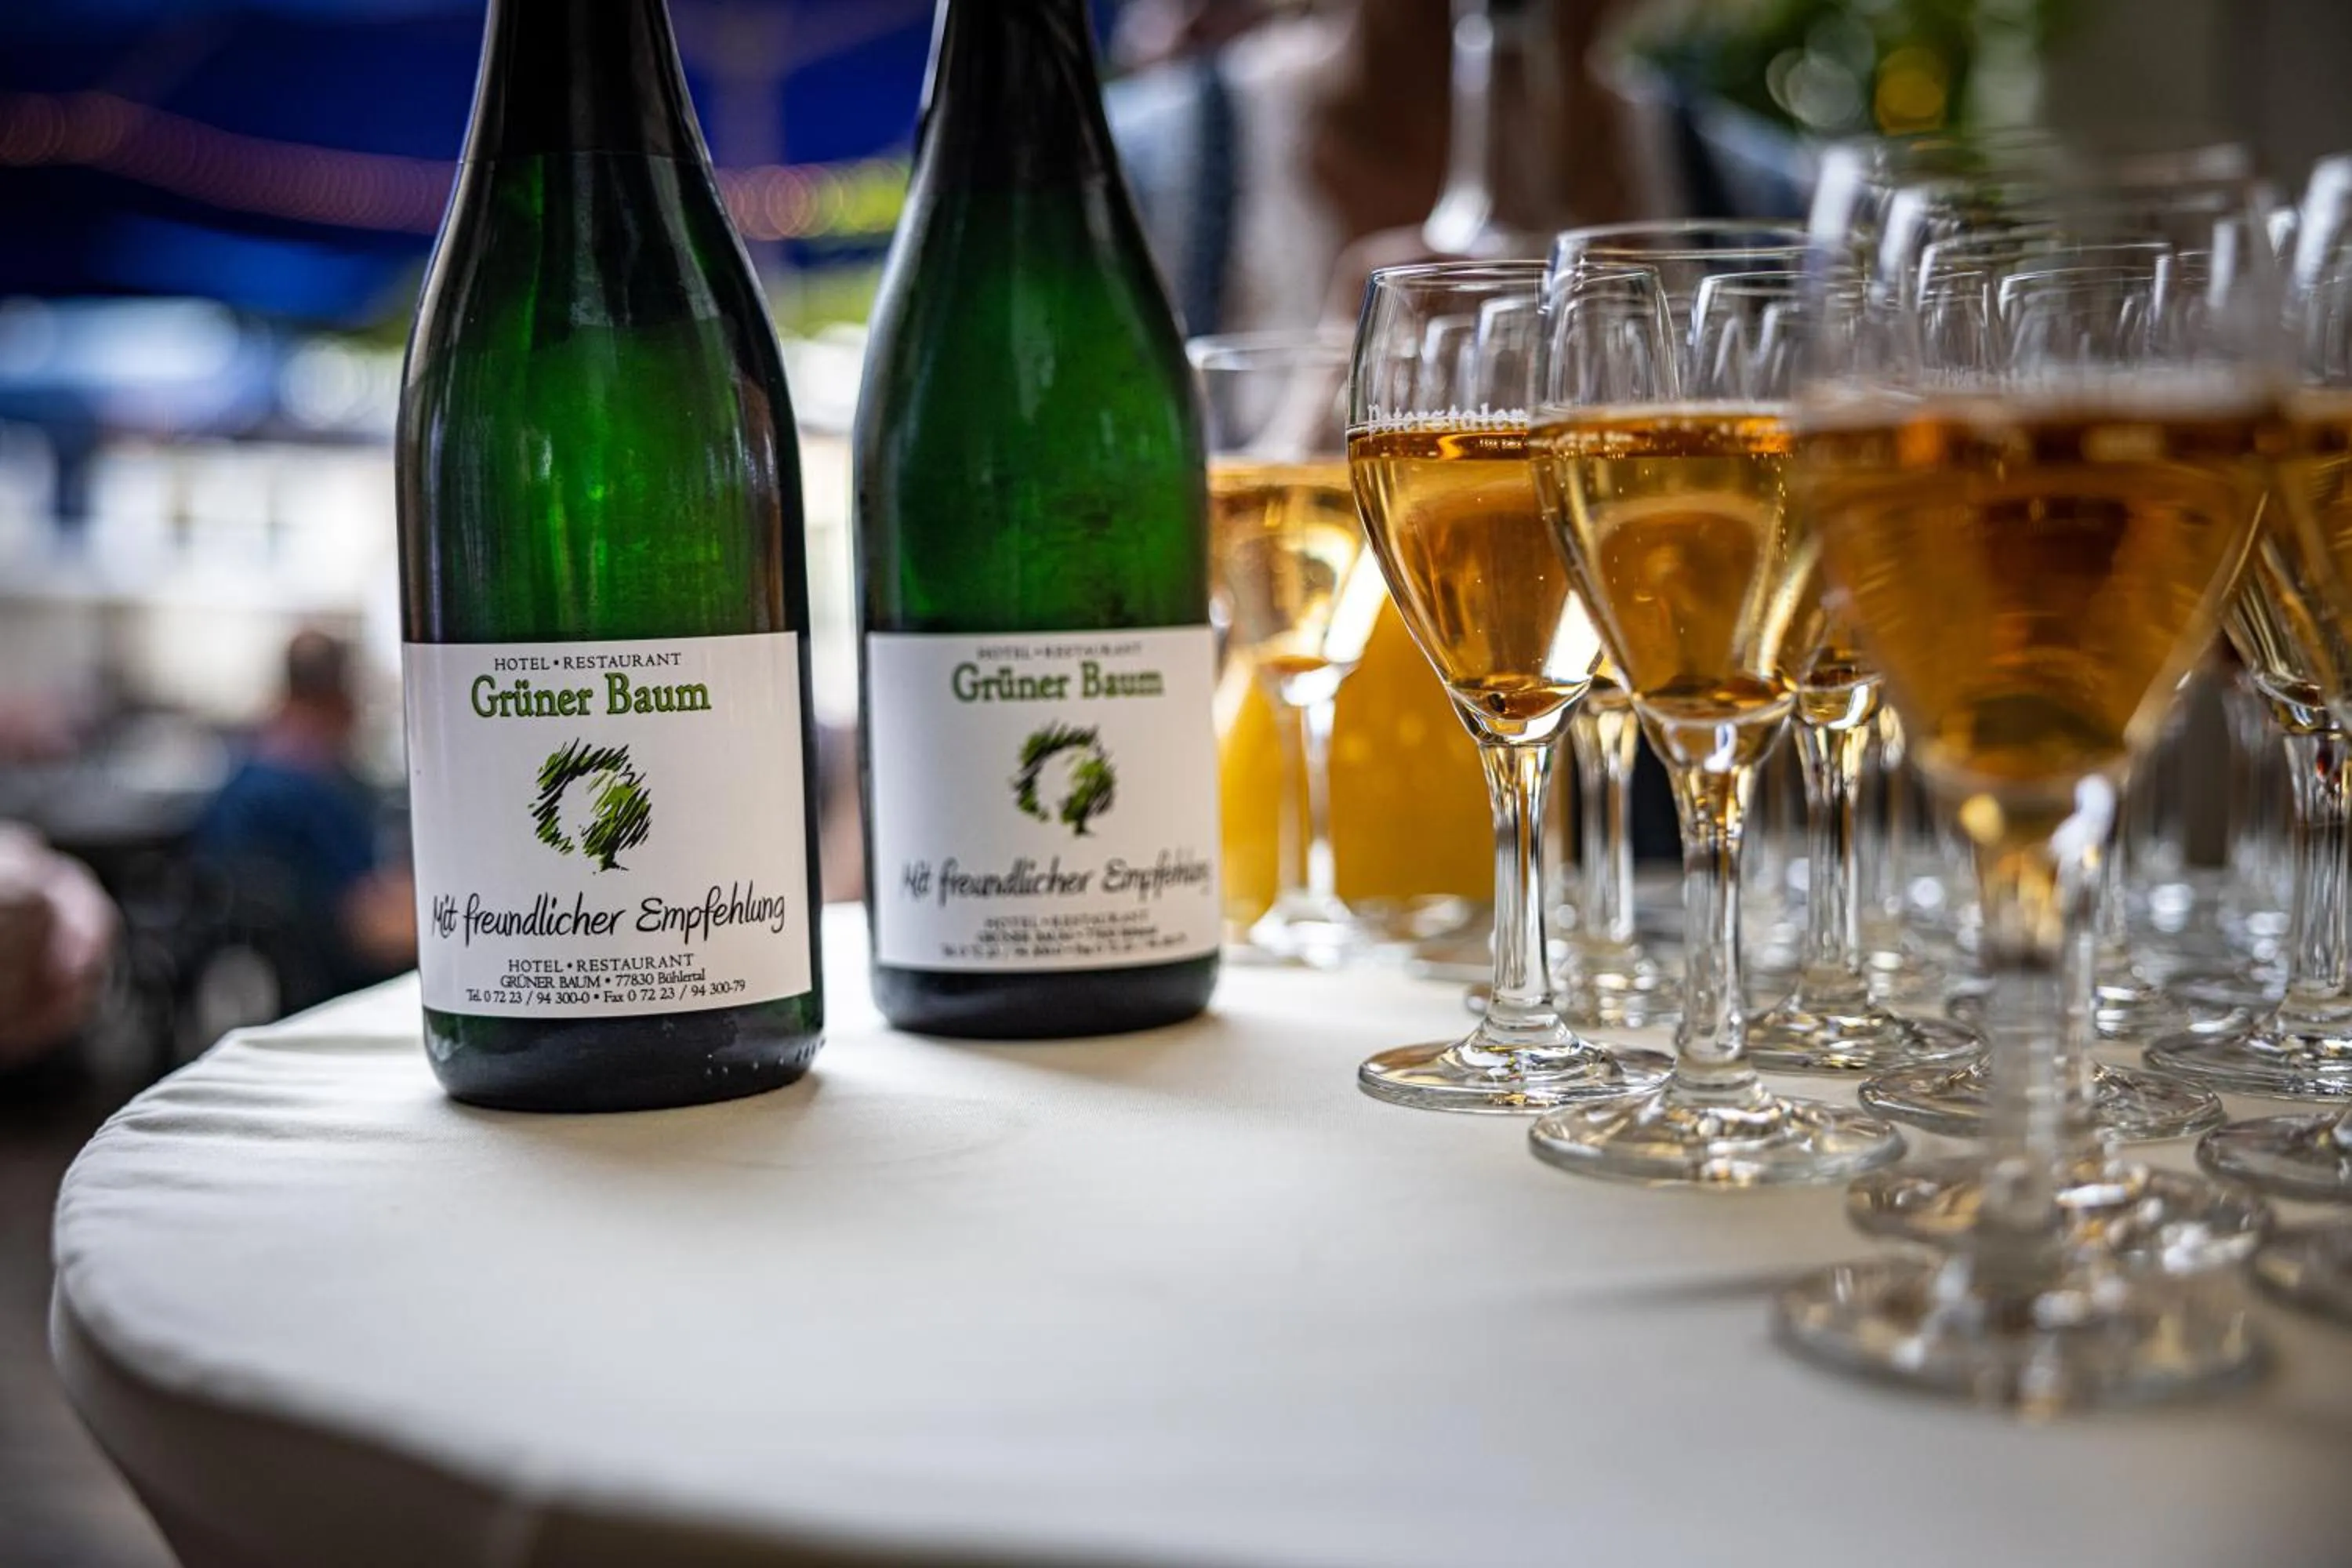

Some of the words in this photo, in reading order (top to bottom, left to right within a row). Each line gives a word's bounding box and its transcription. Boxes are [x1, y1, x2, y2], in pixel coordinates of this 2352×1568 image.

[495, 658, 550, 670] HOTEL
[564, 652, 681, 670] RESTAURANT
[471, 674, 593, 717] Grüner
[604, 673, 711, 714] Baum
[952, 661, 1070, 702] Grüner
[1080, 660, 1165, 698] Baum
[938, 855, 1095, 907] freundlicher
[431, 894, 459, 938] Mit
[463, 891, 626, 948] freundlicher
[636, 880, 785, 945] Empfehlung
[500, 974, 555, 989] GRÜNER
[560, 975, 601, 989] BAUM
[615, 973, 654, 986] 77830
[658, 967, 706, 985] Bühlertal
[509, 959, 564, 972] HOTEL
[577, 953, 694, 971] RESTAURANT
[494, 991, 506, 1003] 72
[510, 992, 522, 1004] 23
[537, 992, 550, 1004] 94
[555, 991, 590, 1004] 300-0
[604, 990, 623, 1003] Fax
[628, 989, 637, 1002] 0
[641, 989, 655, 1001] 72
[659, 988, 675, 1000] 23
[691, 985, 706, 996] 94
[710, 979, 746, 995] 300-79
